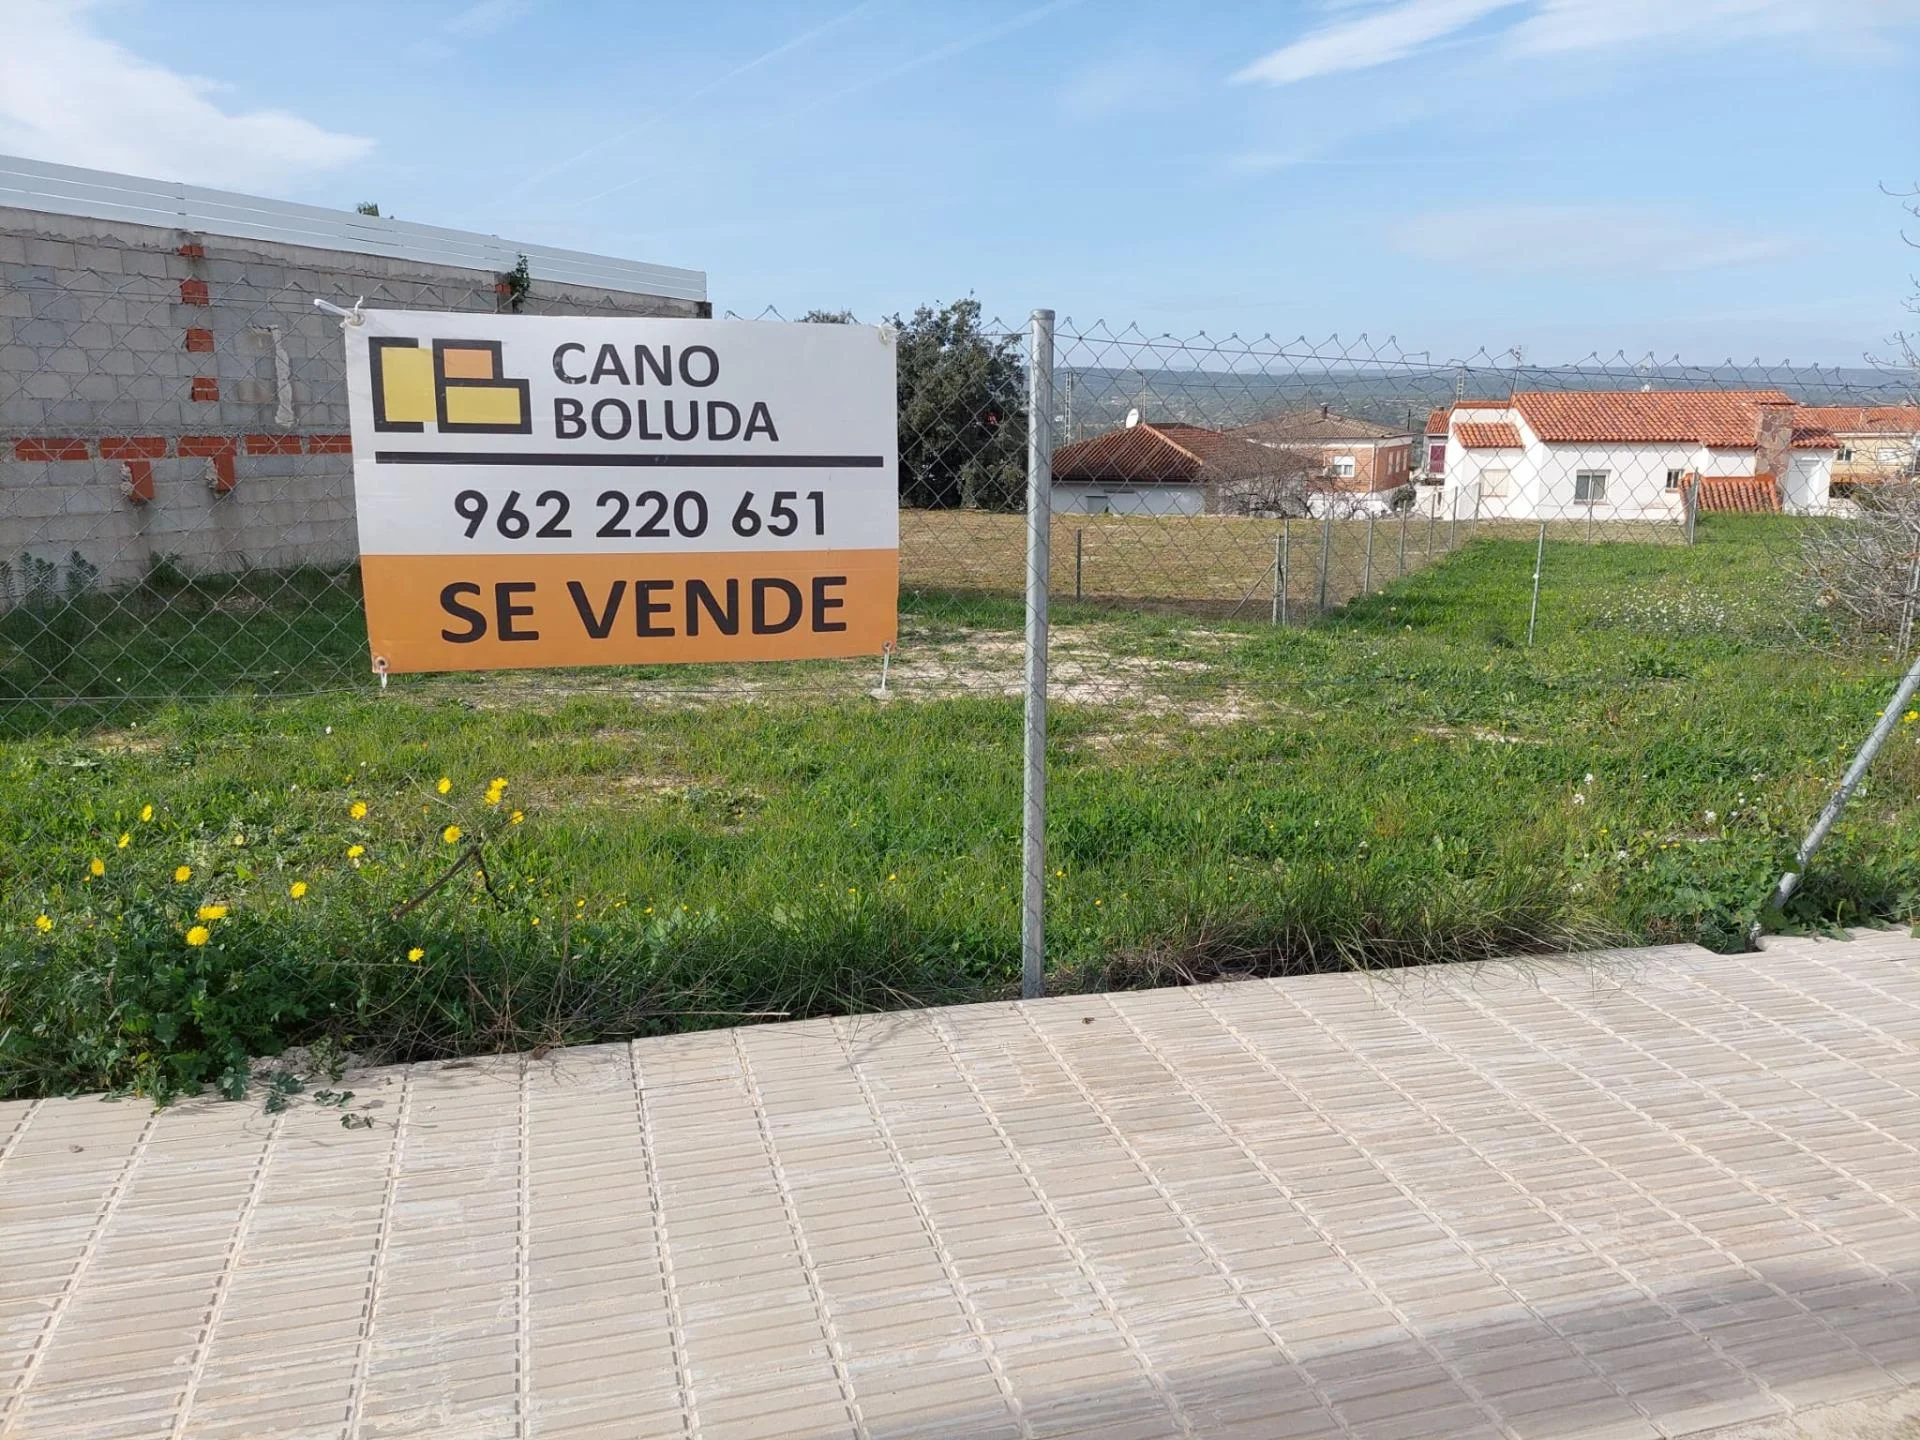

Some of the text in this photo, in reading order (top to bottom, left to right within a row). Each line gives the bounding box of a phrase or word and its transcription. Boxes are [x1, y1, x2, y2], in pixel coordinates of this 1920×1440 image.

[552, 342, 720, 388] CANO
[553, 397, 779, 442] BOLUDA
[454, 489, 825, 540] 962 220 651
[439, 575, 848, 644] SE VENDE
